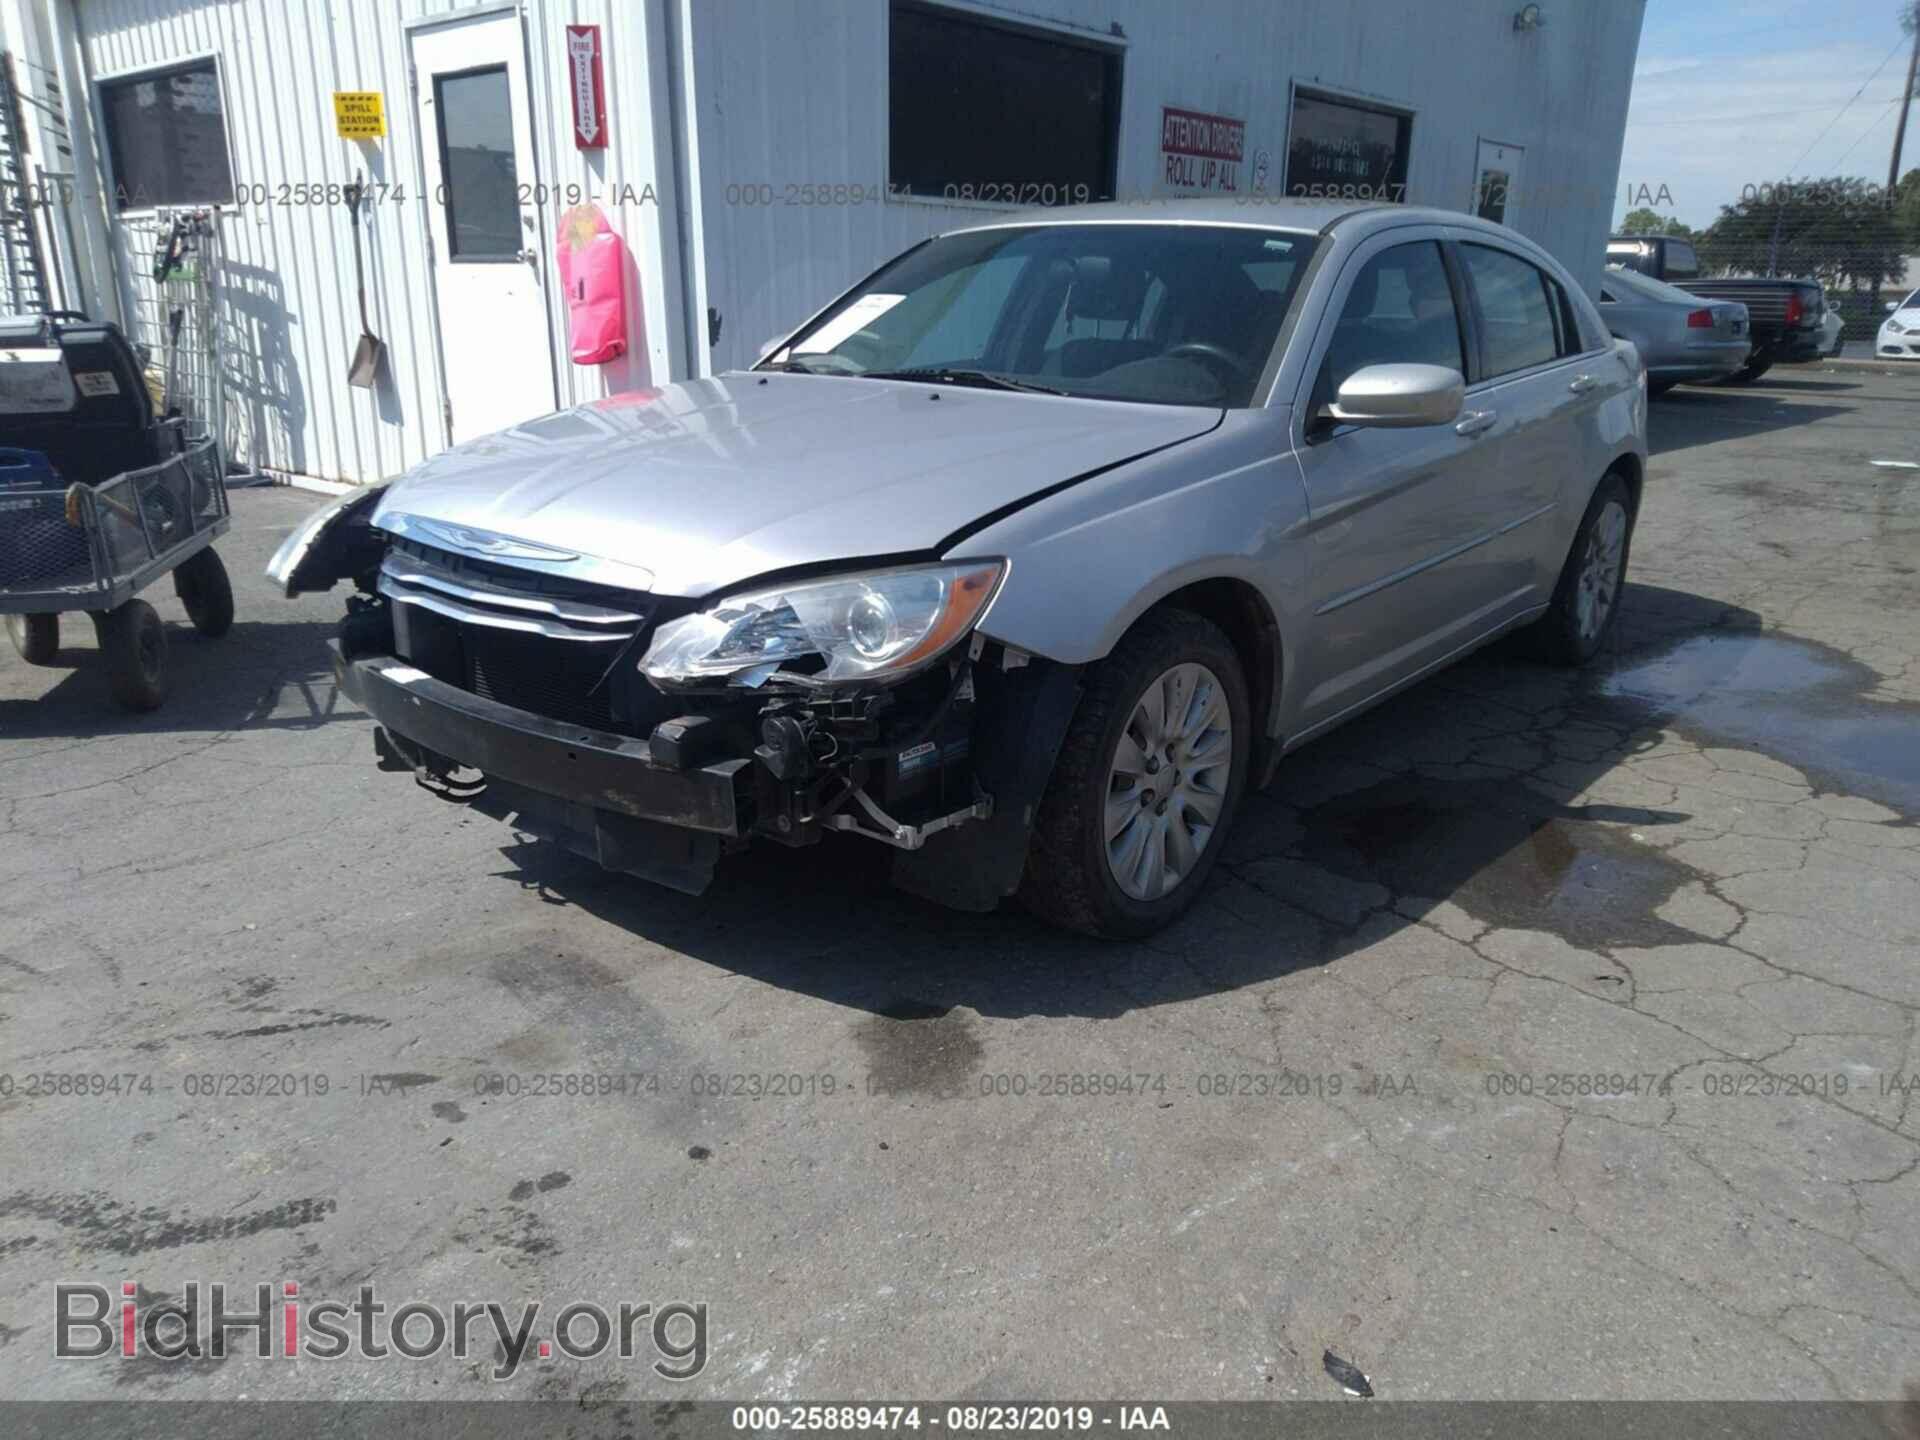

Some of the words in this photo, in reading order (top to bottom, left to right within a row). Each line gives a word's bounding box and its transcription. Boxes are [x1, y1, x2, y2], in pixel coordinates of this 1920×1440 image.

[339, 115, 380, 125] STATION
[344, 104, 372, 113] SPILL
[1166, 114, 1210, 153] ATTENTION
[1166, 155, 1195, 187] ROLL
[1200, 158, 1216, 191] UP
[1218, 162, 1237, 192] ALL
